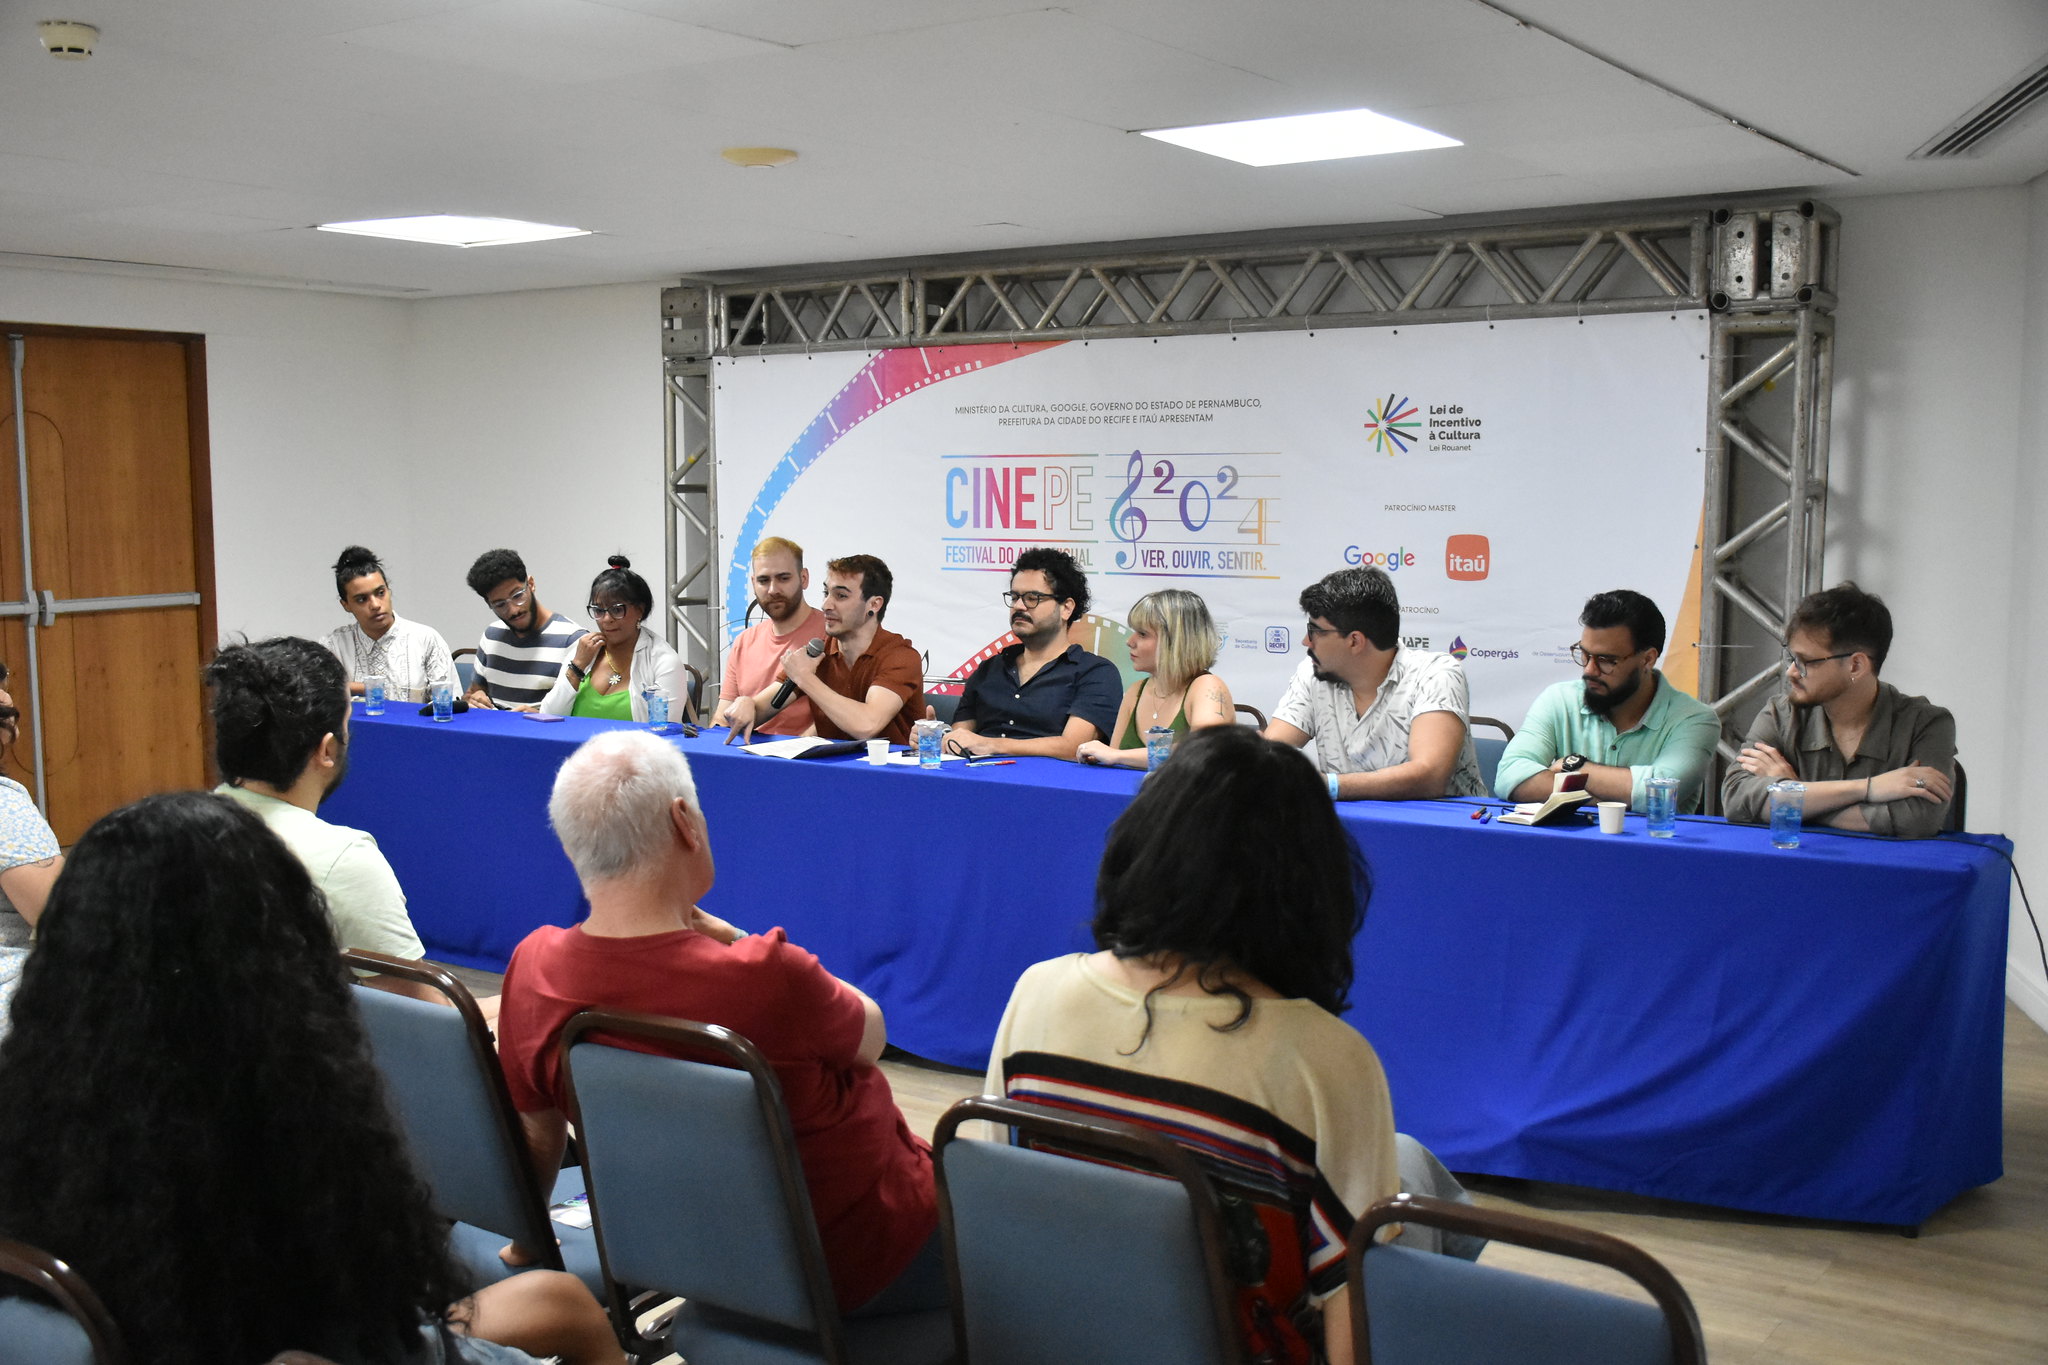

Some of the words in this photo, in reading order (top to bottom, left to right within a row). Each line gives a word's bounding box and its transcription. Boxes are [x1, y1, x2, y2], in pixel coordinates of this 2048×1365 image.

[955, 405, 997, 414] MINISTÉRIO
[999, 405, 1010, 414] DA
[1012, 404, 1048, 414] CULTURA,
[1050, 403, 1088, 412] GOOGLE,
[1090, 402, 1133, 411] GOVERNO
[1135, 402, 1148, 410] DO
[1150, 400, 1184, 410] ESTADO
[1186, 400, 1196, 409] DE
[1198, 398, 1262, 409] PERNAMBUCO,
[1430, 405, 1446, 414] Lei
[1449, 404, 1463, 414] de
[998, 417, 1042, 426] PREFEITURA
[1044, 416, 1055, 425] DA
[1058, 416, 1086, 425] CIDADE
[1088, 416, 1102, 424] DO
[1104, 415, 1130, 424] RECIFE
[1132, 415, 1136, 424] E
[1140, 414, 1158, 424] ITAÚ
[1160, 414, 1214, 423] APRESENTAM
[1429, 417, 1482, 428] Incentivo
[1429, 430, 1436, 440] à
[1438, 430, 1480, 440] Cultura
[1384, 504, 1426, 512] PATROCÍNIO
[946, 546, 996, 564] FESTIVAL
[998, 546, 1014, 564] DO
[1141, 550, 1168, 569] VER,
[1172, 550, 1214, 570] OUVIR,
[1218, 551, 1267, 571] SENTIR.
[1344, 545, 1415, 572] Google
[1450, 554, 1486, 572] itaú
[1470, 648, 1519, 660] Copergás
